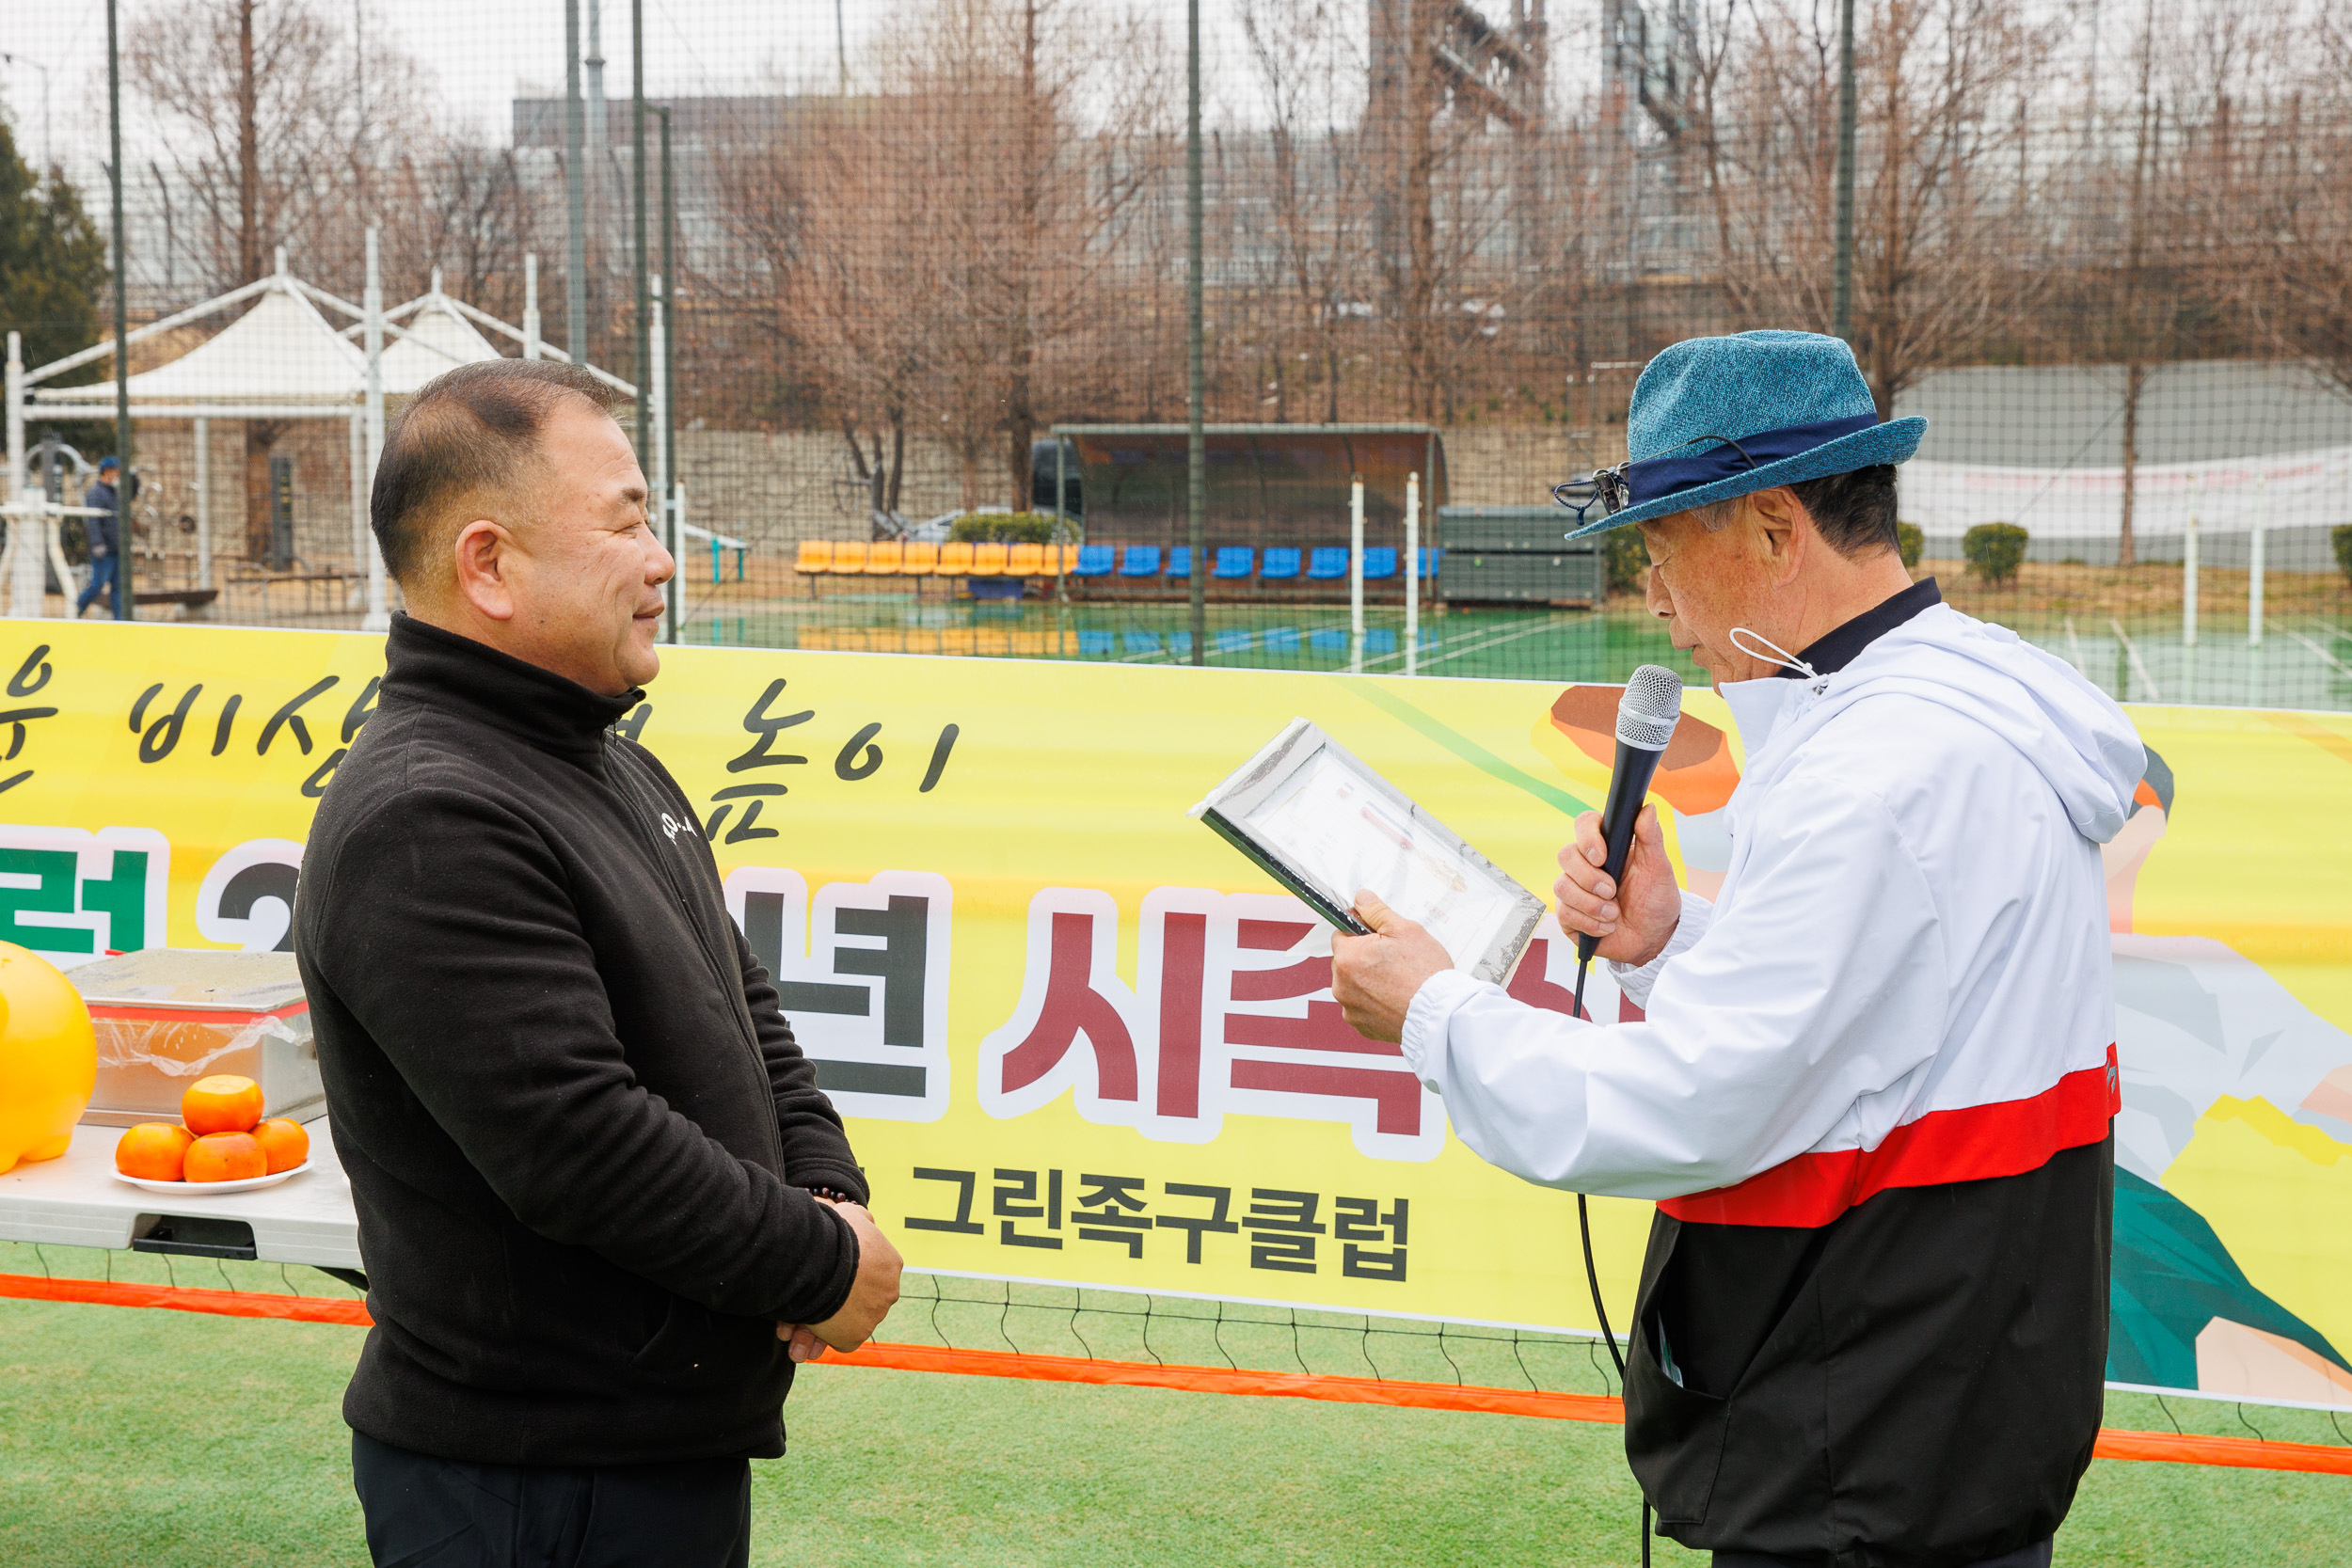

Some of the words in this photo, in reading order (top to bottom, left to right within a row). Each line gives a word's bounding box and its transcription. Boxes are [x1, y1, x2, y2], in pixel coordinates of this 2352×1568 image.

[707, 678, 960, 845] 높이
[1001, 911, 1646, 1137] 시족
[904, 1166, 1409, 1283] 그린족구클럽
